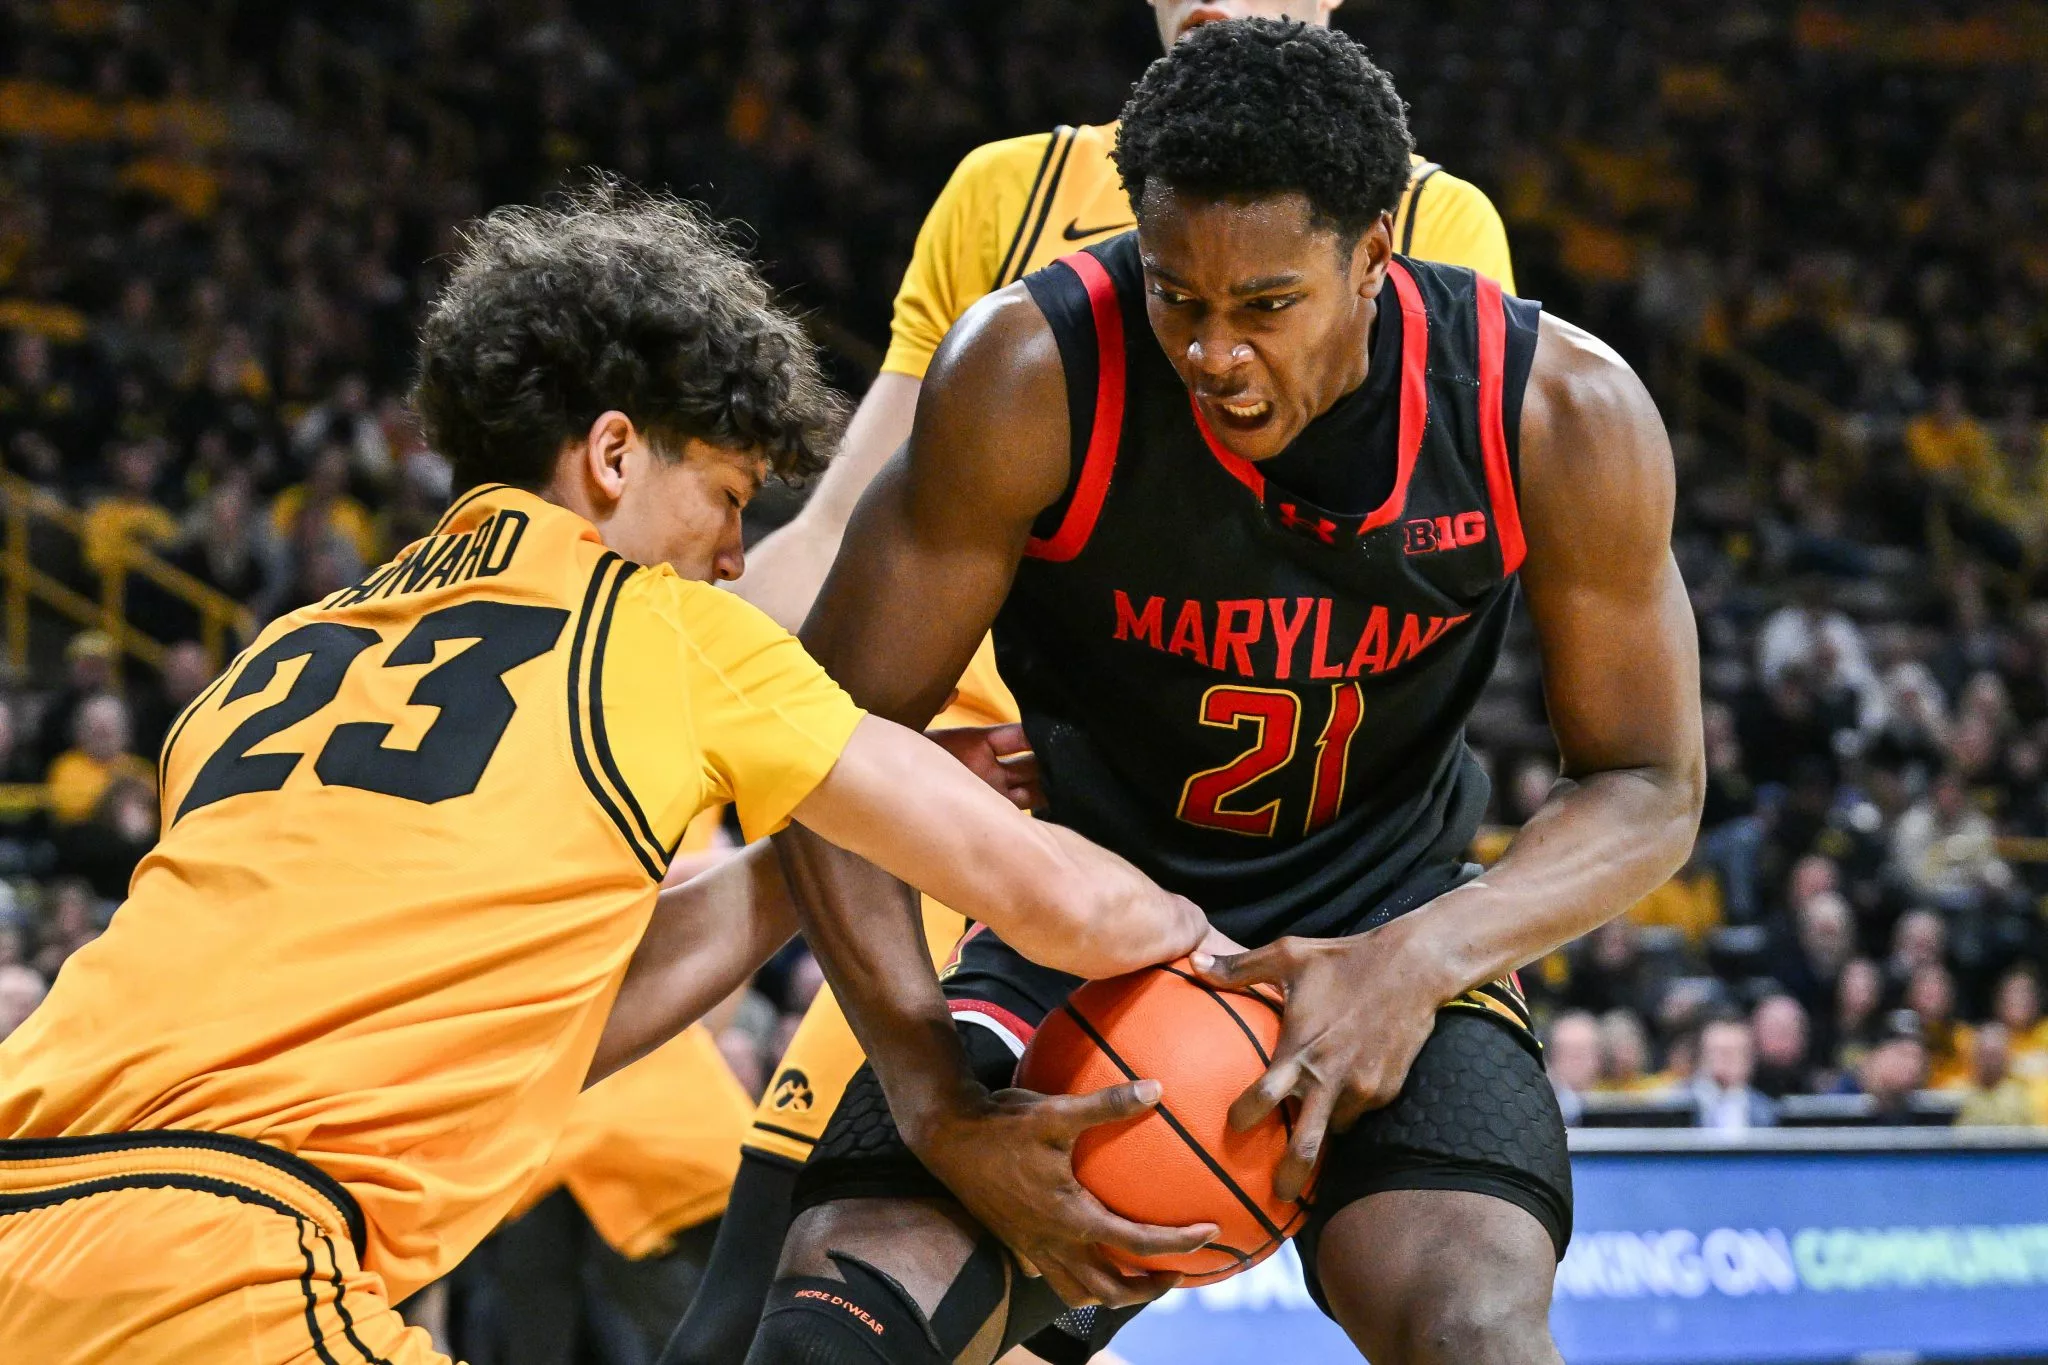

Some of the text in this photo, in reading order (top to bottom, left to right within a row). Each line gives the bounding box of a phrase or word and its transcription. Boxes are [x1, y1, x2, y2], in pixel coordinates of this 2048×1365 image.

[1112, 589, 1472, 680] MARYLAN
[170, 600, 572, 830] 23
[1175, 681, 1365, 838] 21
